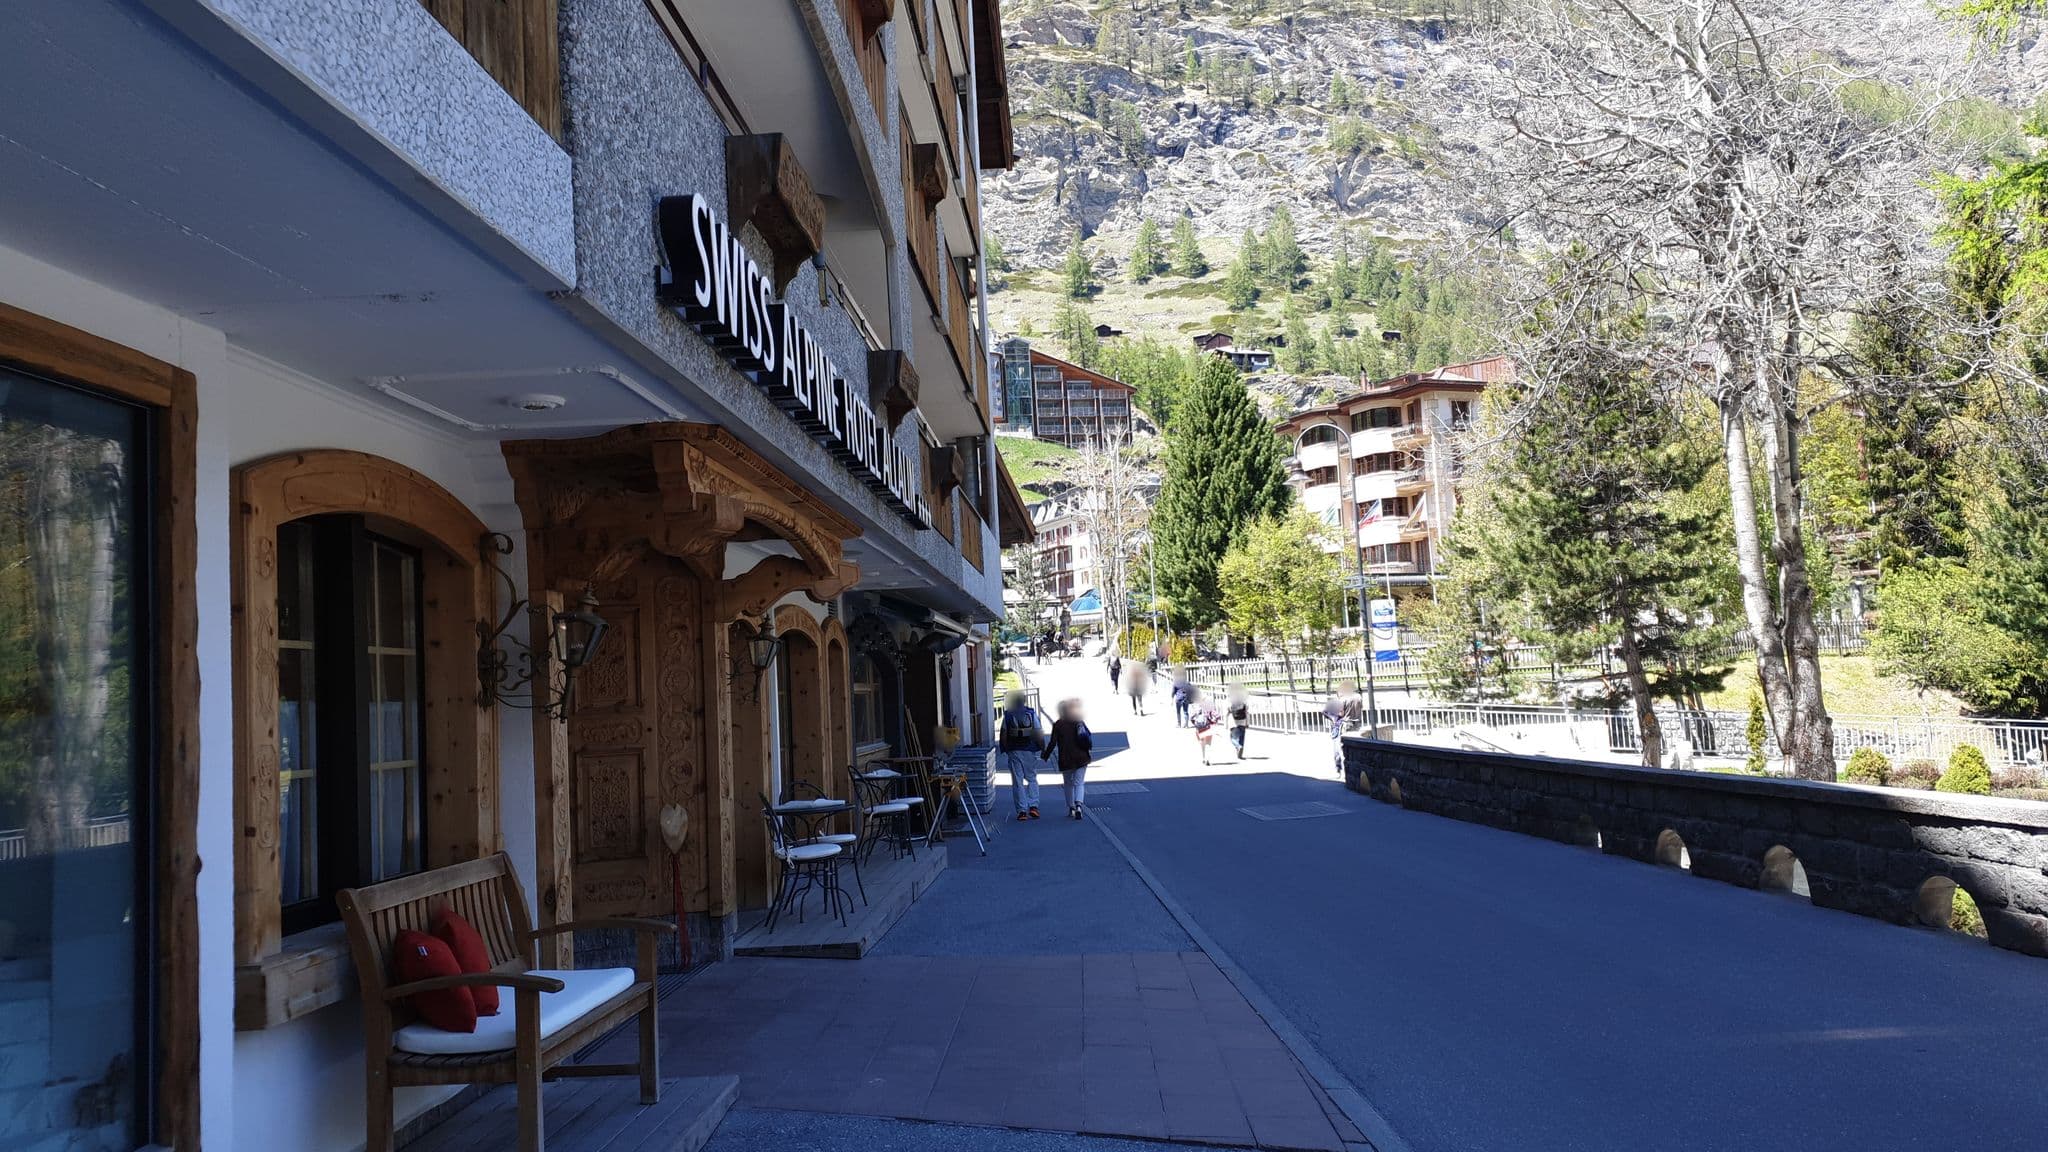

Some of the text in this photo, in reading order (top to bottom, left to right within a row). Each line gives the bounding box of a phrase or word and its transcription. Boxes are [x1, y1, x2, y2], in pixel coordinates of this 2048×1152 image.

[692, 192, 775, 373] SWISS
[783, 305, 841, 441] ALPINE
[843, 377, 882, 481] HOTEL
